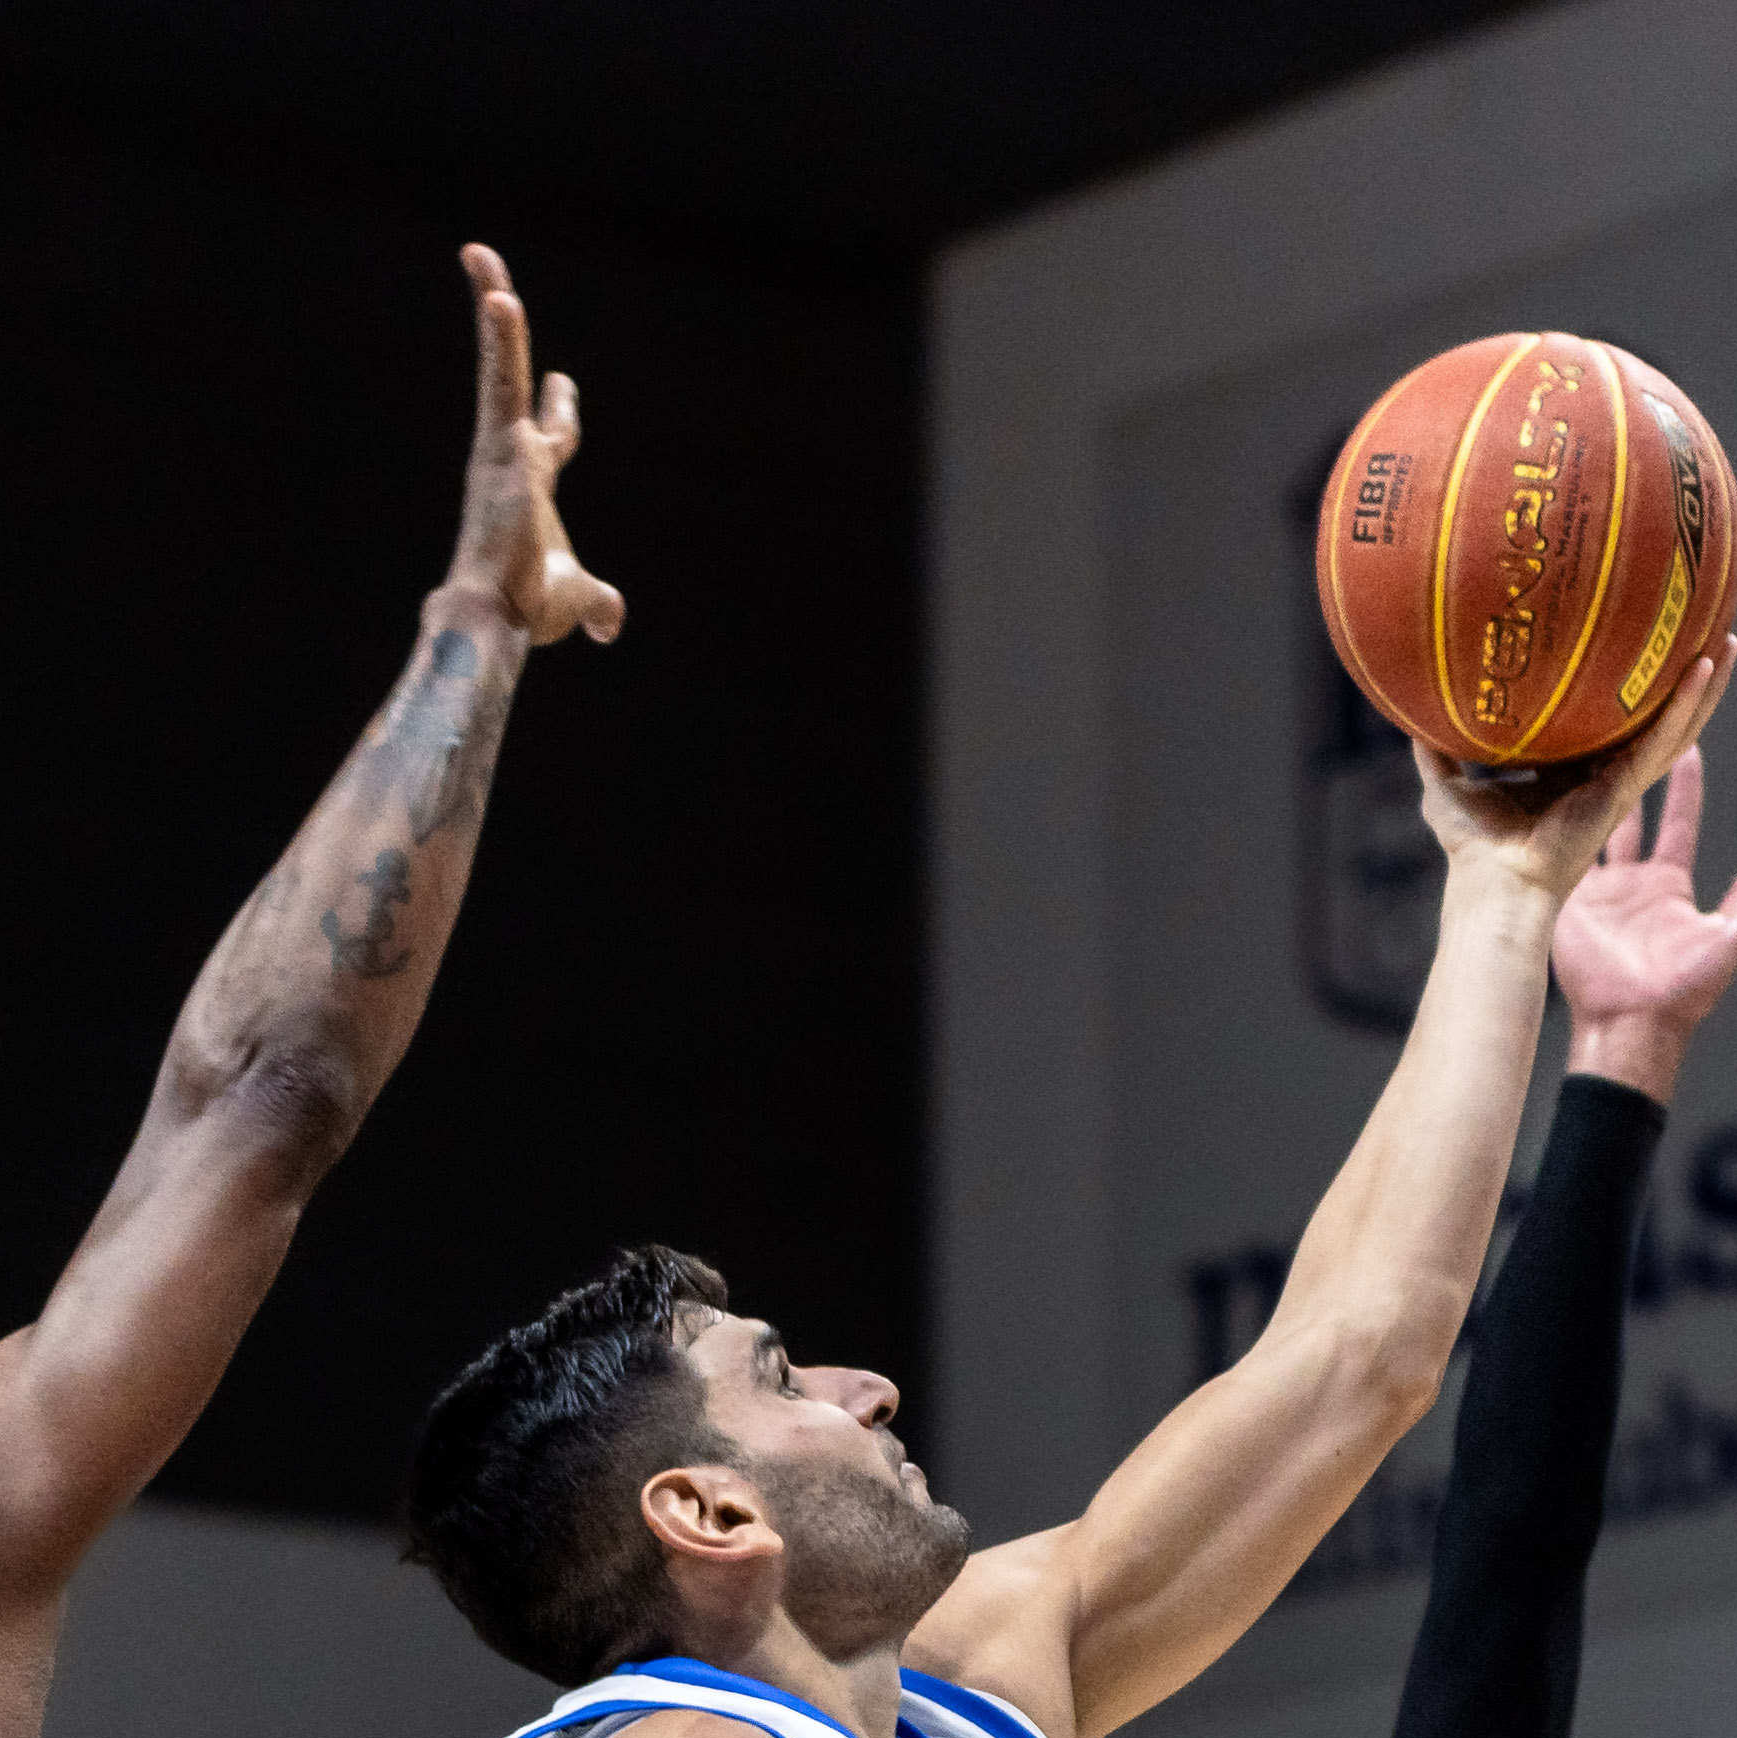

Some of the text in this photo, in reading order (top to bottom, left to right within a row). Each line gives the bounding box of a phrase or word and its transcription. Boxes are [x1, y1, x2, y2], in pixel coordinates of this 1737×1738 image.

[1352, 452, 1397, 545] FIBA
[1474, 360, 1585, 729] PENALTY
[1621, 582, 1685, 699] CROSS
